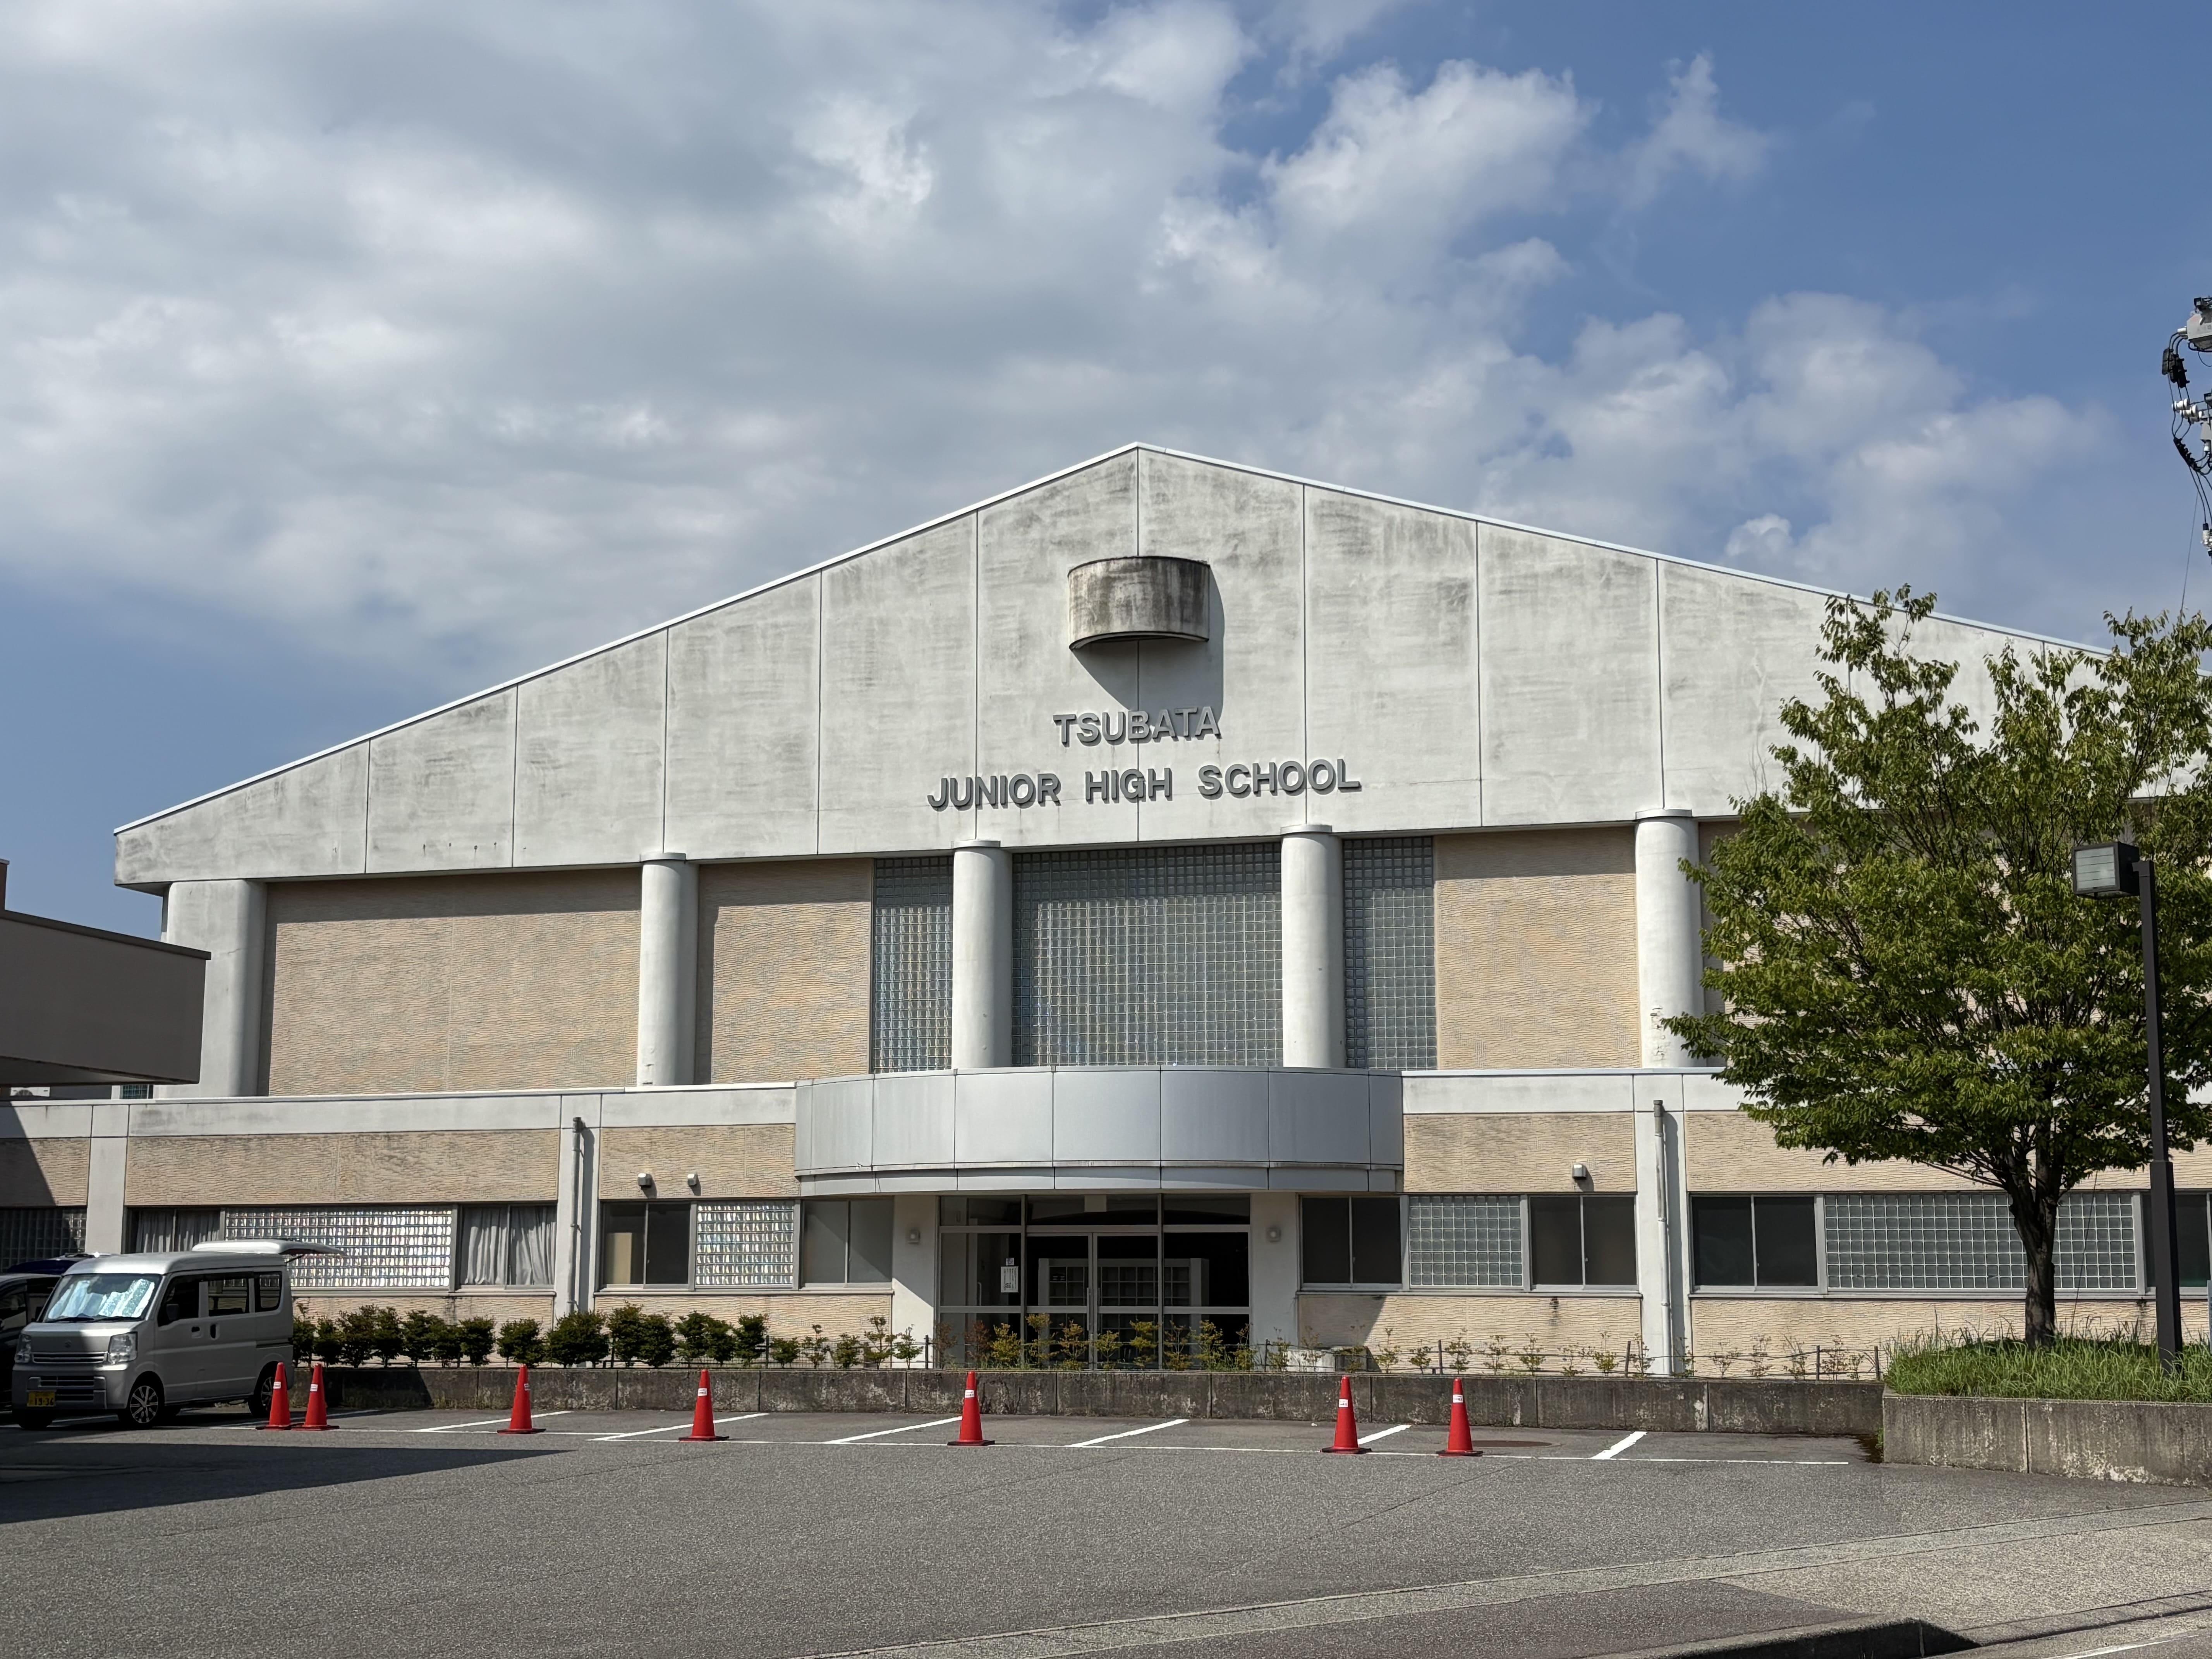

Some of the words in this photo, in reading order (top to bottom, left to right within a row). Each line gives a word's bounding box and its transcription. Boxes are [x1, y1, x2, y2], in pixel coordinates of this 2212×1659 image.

[1053, 706, 1221, 744] TSUBATA
[927, 773, 1060, 807] JUNIOR
[1085, 767, 1171, 801] HIGH
[1197, 758, 1360, 795] SCHOOL
